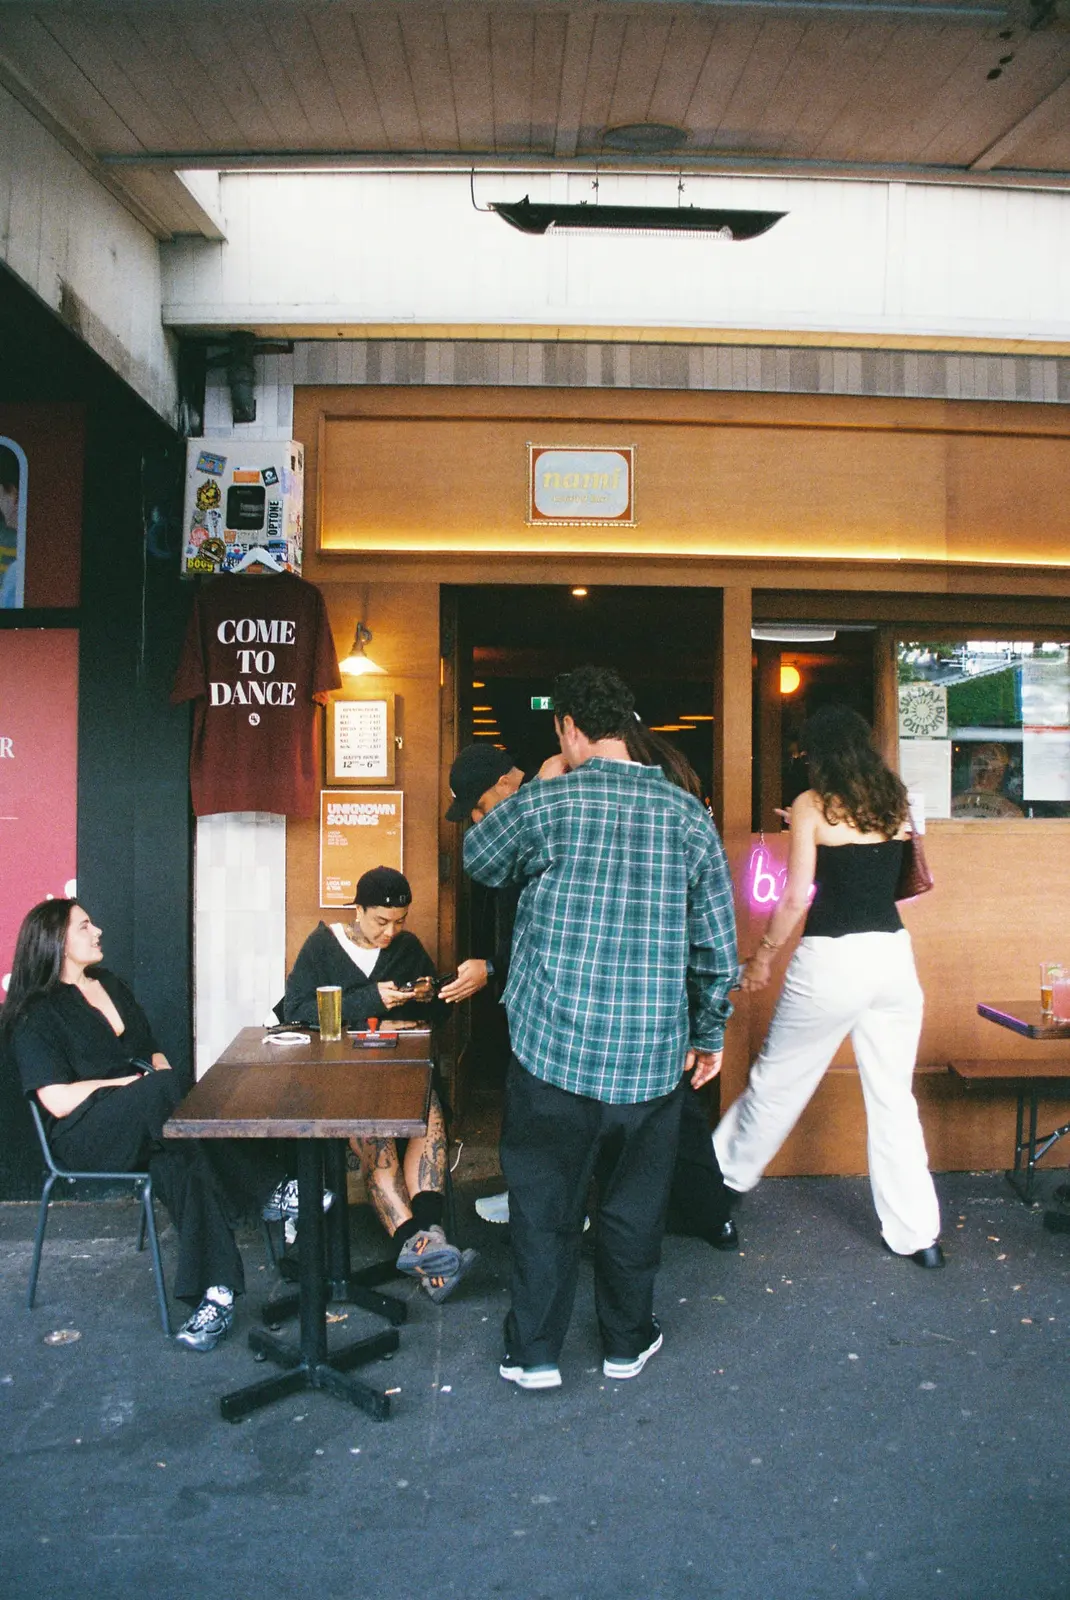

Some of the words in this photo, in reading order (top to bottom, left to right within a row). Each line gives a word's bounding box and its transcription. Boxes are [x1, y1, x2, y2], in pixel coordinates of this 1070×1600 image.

[543, 466, 622, 490] nami
[268, 500, 279, 536] OPTONE
[217, 619, 296, 645] COME
[236, 649, 276, 675] TO
[209, 681, 297, 706] DANCE
[902, 706, 946, 735] BURRITO
[326, 814, 379, 826] SOUNDS
[327, 803, 396, 815] UNKNOWN
